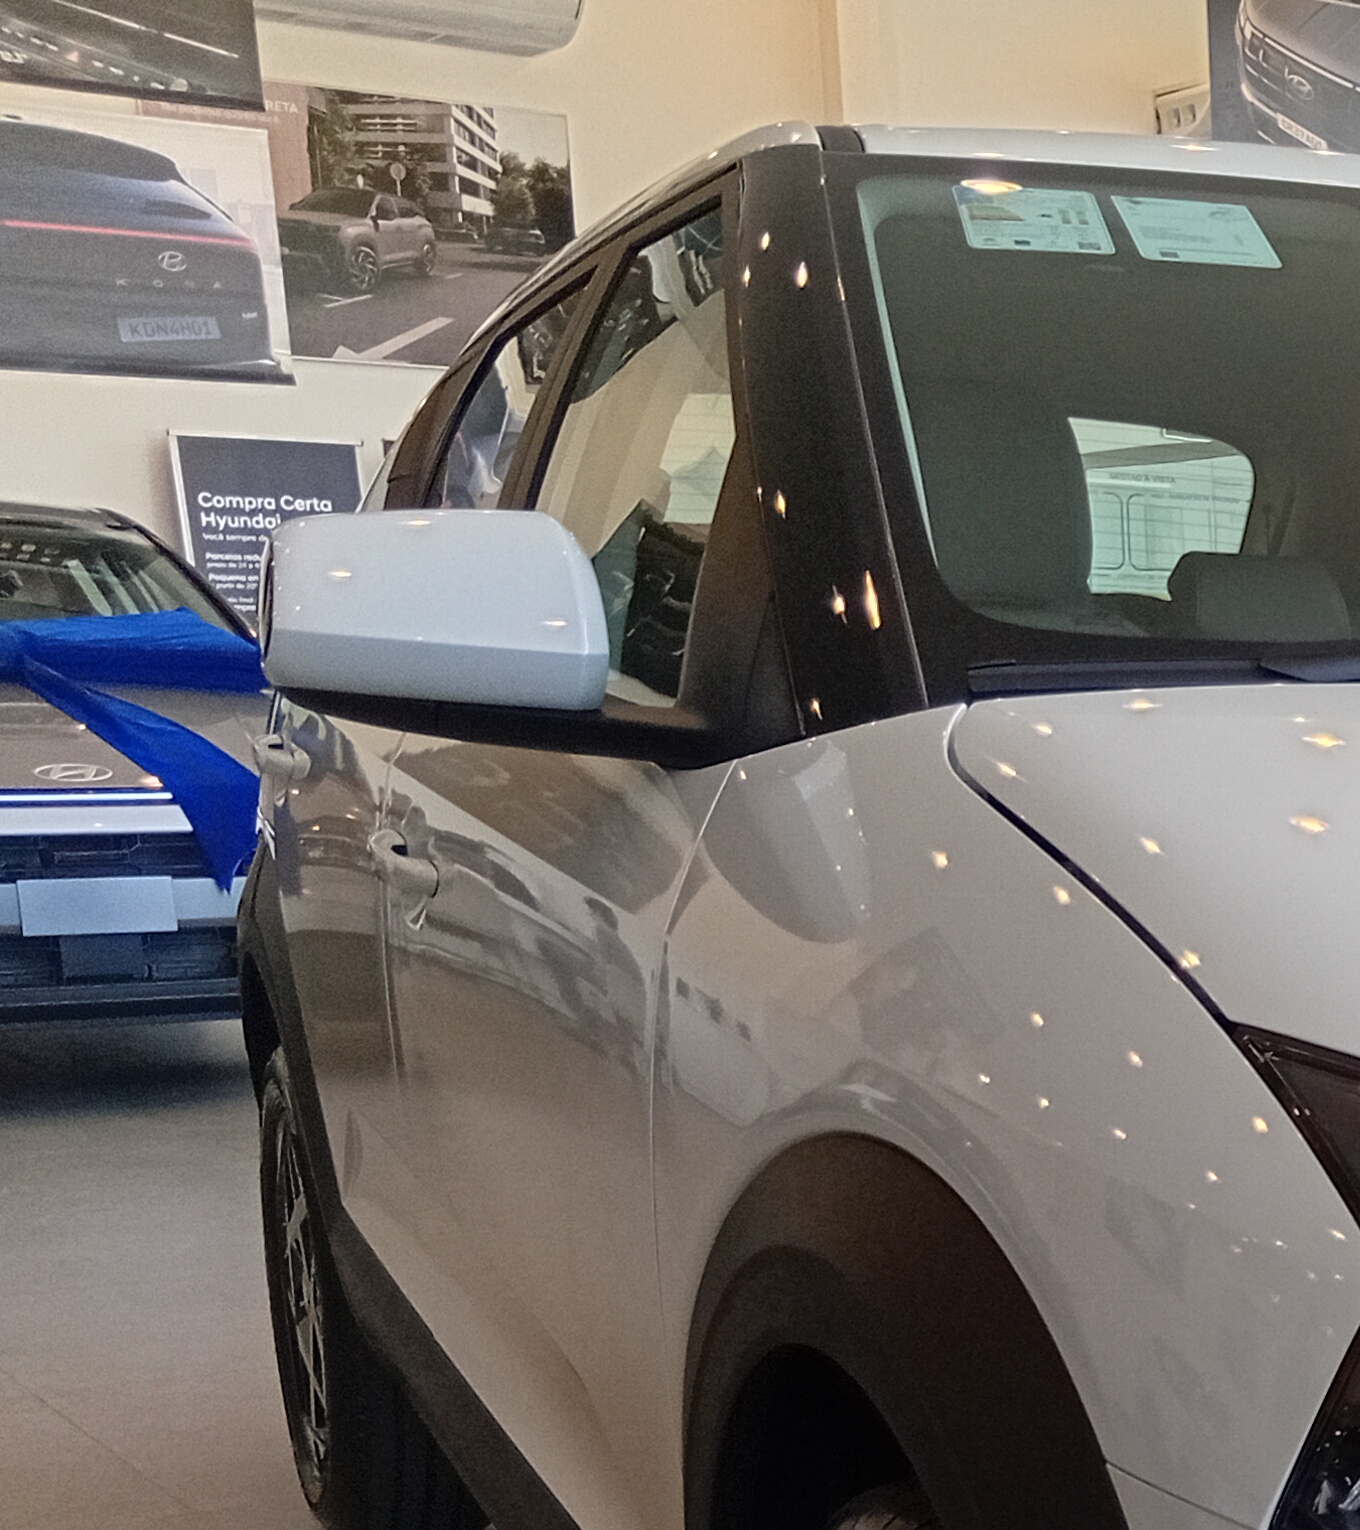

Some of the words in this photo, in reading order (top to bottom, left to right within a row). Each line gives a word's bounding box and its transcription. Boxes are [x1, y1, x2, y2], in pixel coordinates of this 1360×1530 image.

[264, 100, 299, 114] RETA
[197, 491, 276, 512] Compra
[280, 495, 333, 512] Certa
[200, 512, 282, 531] Hyundai
